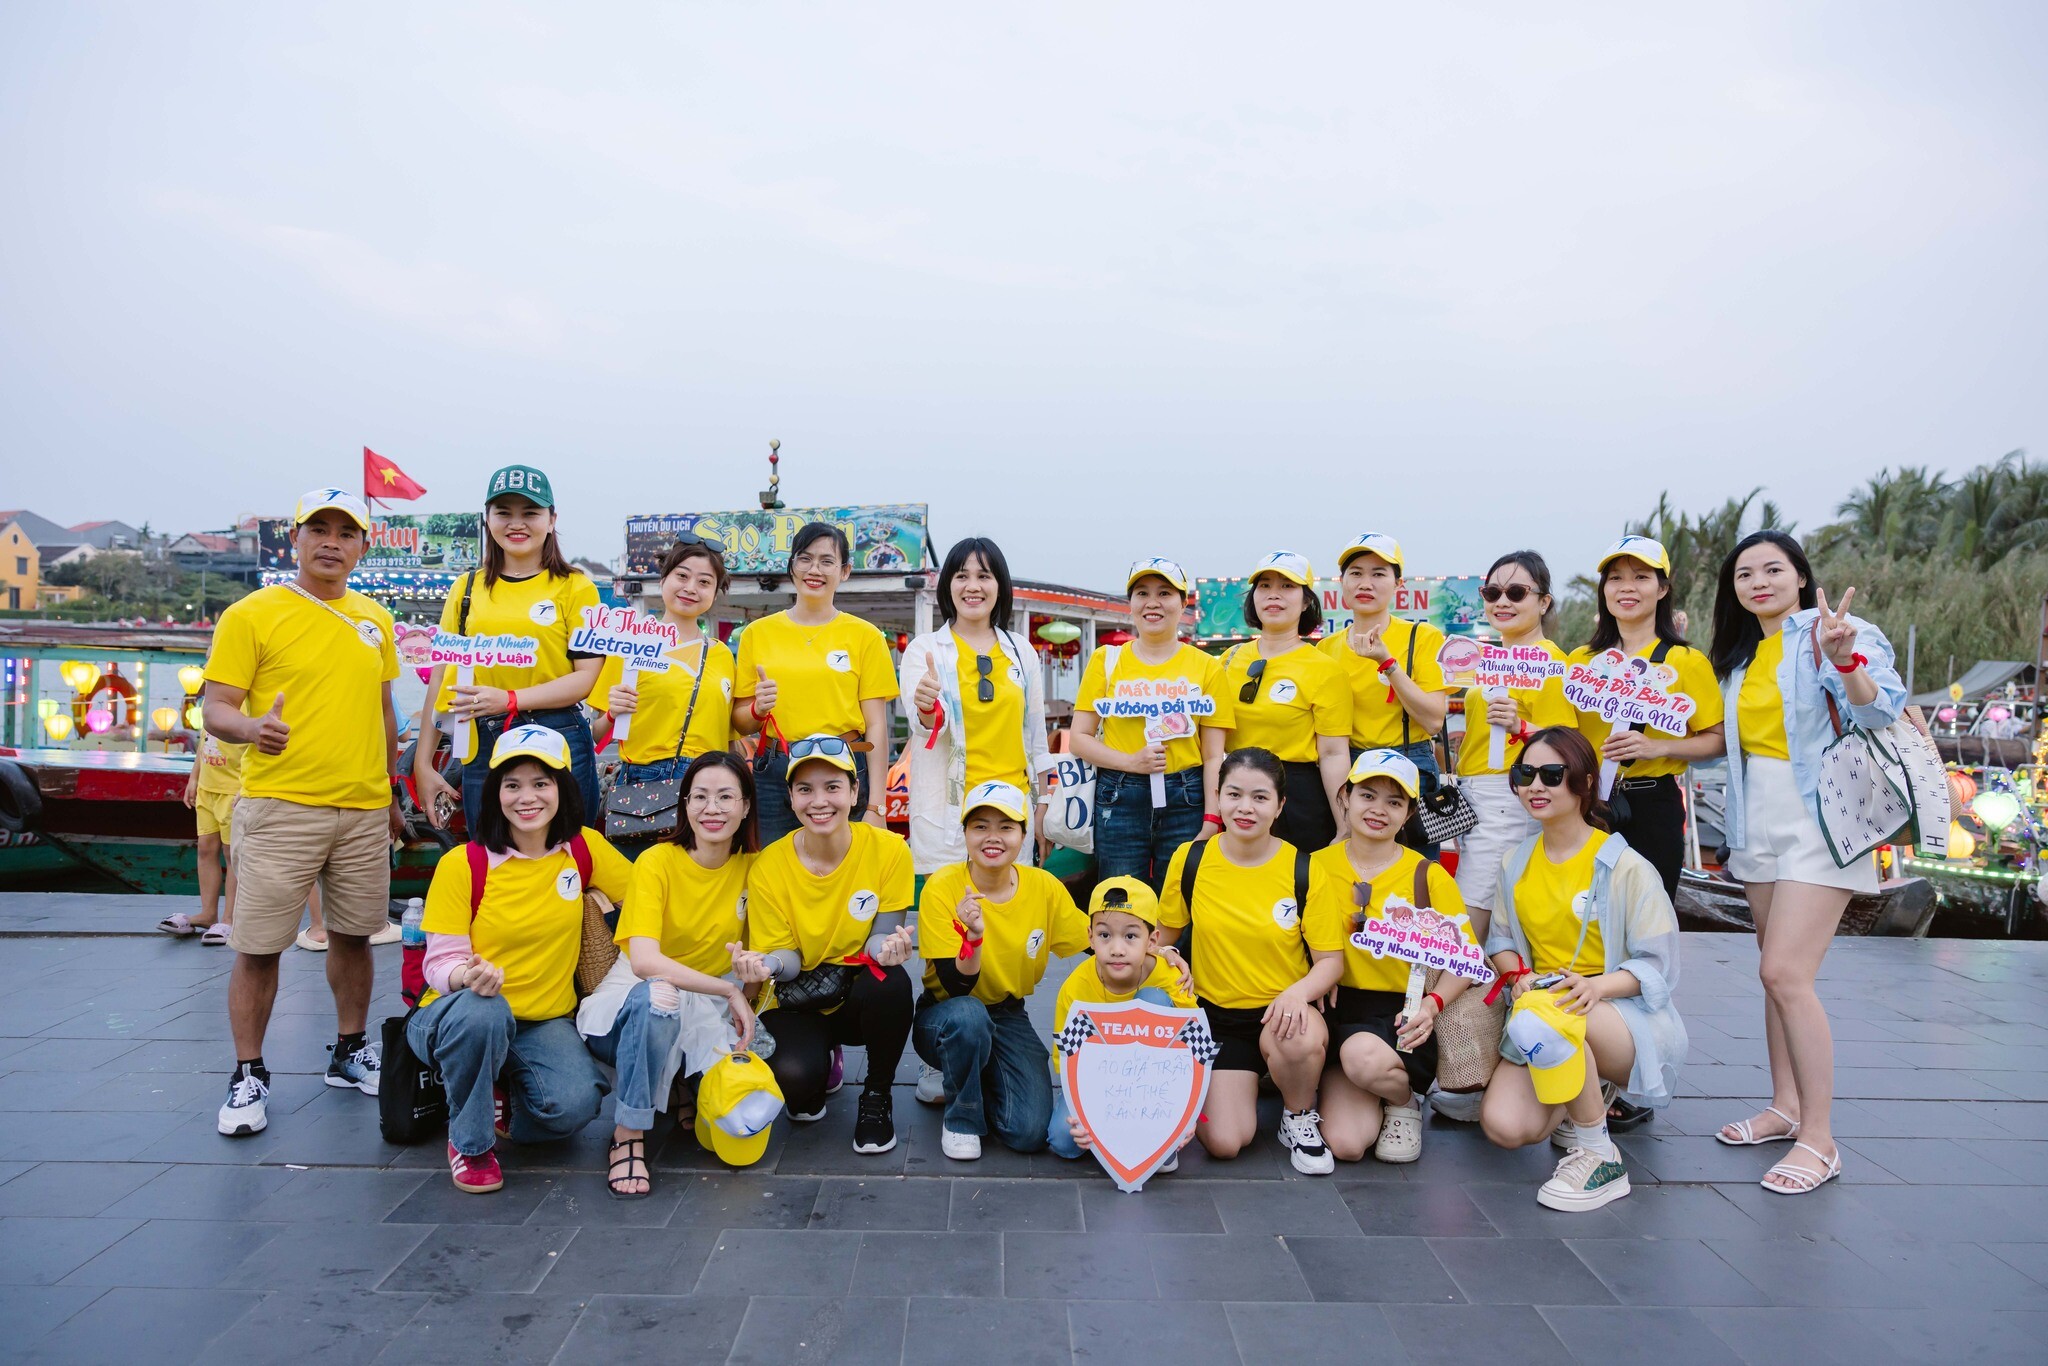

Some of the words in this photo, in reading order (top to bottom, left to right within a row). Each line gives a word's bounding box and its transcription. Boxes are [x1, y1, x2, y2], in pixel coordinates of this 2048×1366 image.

[493, 470, 541, 493] ABC
[660, 521, 671, 531] DU
[369, 520, 418, 554] Huy
[367, 558, 387, 566] 0328
[389, 558, 404, 566] 975
[406, 557, 422, 566] 279
[586, 606, 611, 629] Vé
[433, 633, 471, 652] Không
[474, 635, 493, 650] Lợi
[496, 636, 534, 651] Nhuận
[573, 628, 663, 658] Vietravel
[431, 650, 472, 665] Đừng
[476, 652, 493, 665] Lý
[498, 652, 533, 665] Luận
[1483, 646, 1508, 659] Em
[1513, 646, 1549, 661] Hiền
[631, 657, 668, 670] Airlines
[1118, 682, 1151, 697] Mất
[1155, 681, 1187, 699] Ngủ
[1476, 673, 1499, 686] Hơi
[1503, 674, 1541, 688] Phiền
[1570, 666, 1607, 694] Đồng
[1609, 678, 1637, 698] Đội
[1636, 687, 1668, 707] Bên
[1671, 696, 1690, 713] Ta
[1097, 702, 1111, 715] Vì
[1115, 700, 1159, 717] Không
[1161, 698, 1184, 713] Đối
[1188, 699, 1213, 713] Thủ
[1565, 684, 1604, 710] Ngại
[1621, 701, 1644, 721] Tía
[1648, 709, 1683, 733] Má
[1368, 920, 1406, 942] Đồng
[1410, 932, 1460, 955] Nghiệp
[1463, 945, 1480, 960] Là
[1353, 933, 1384, 955] Cùng
[1388, 942, 1419, 959] Nhau
[1424, 952, 1445, 966] Tạo
[1449, 959, 1492, 981] Nghiệp
[1101, 1022, 1149, 1037] TEAM
[1154, 1027, 1175, 1038] 03
